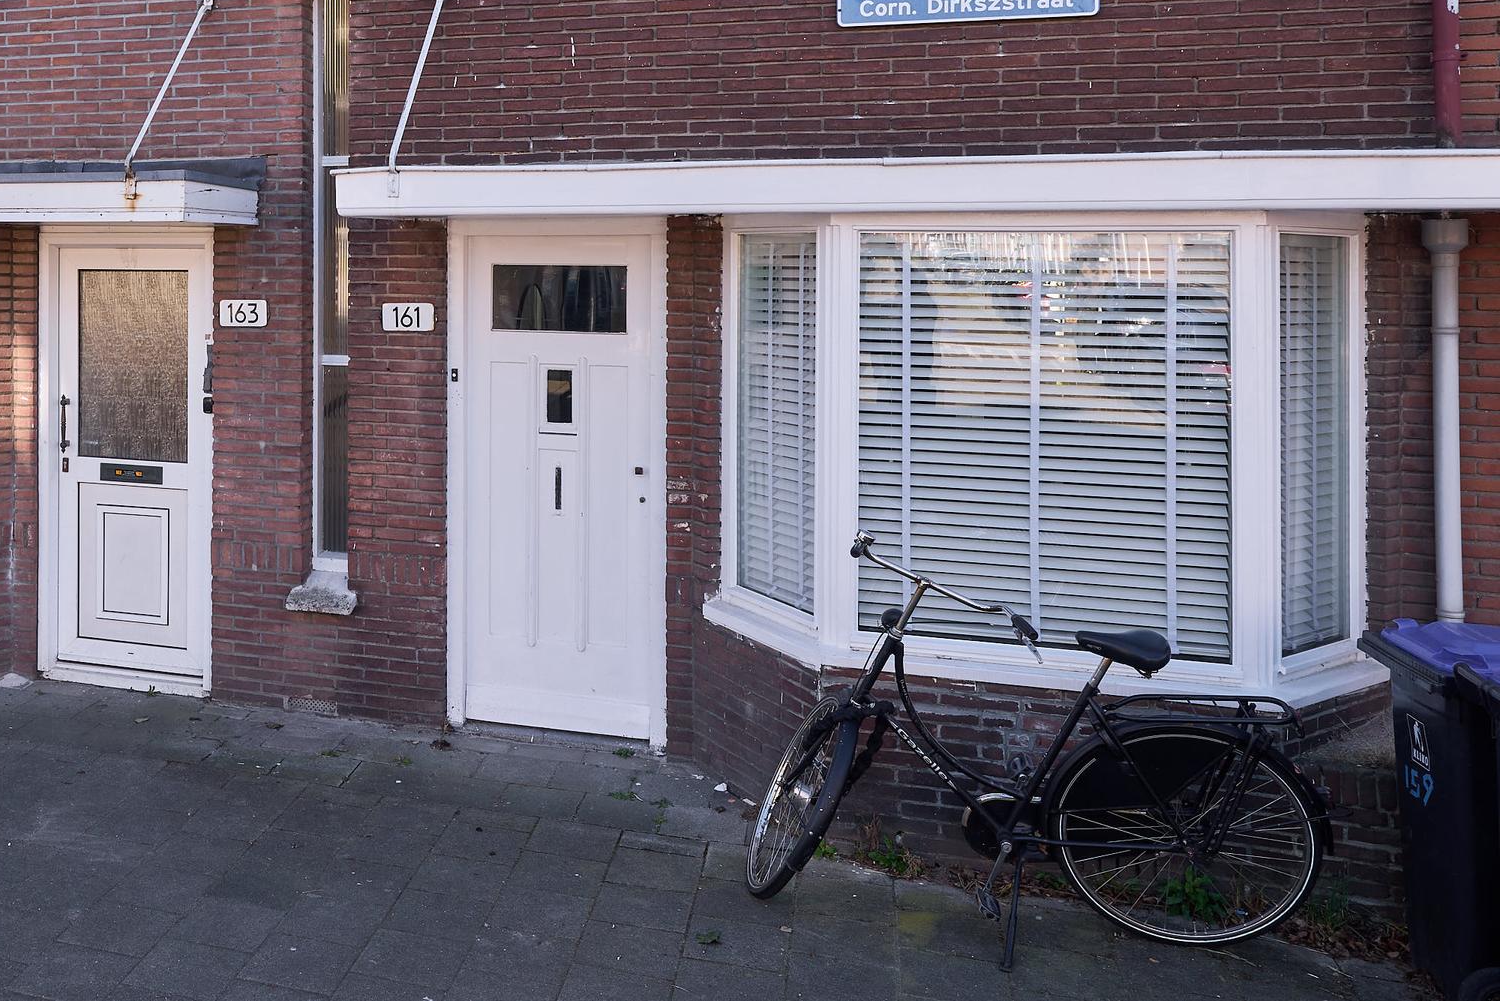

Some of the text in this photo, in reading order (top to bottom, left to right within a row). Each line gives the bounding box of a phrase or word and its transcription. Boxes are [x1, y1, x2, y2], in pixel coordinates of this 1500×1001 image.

[859, 0, 917, 18] Corn.
[227, 303, 259, 324] 163
[392, 306, 421, 329] 161
[1405, 764, 1434, 806] 159
